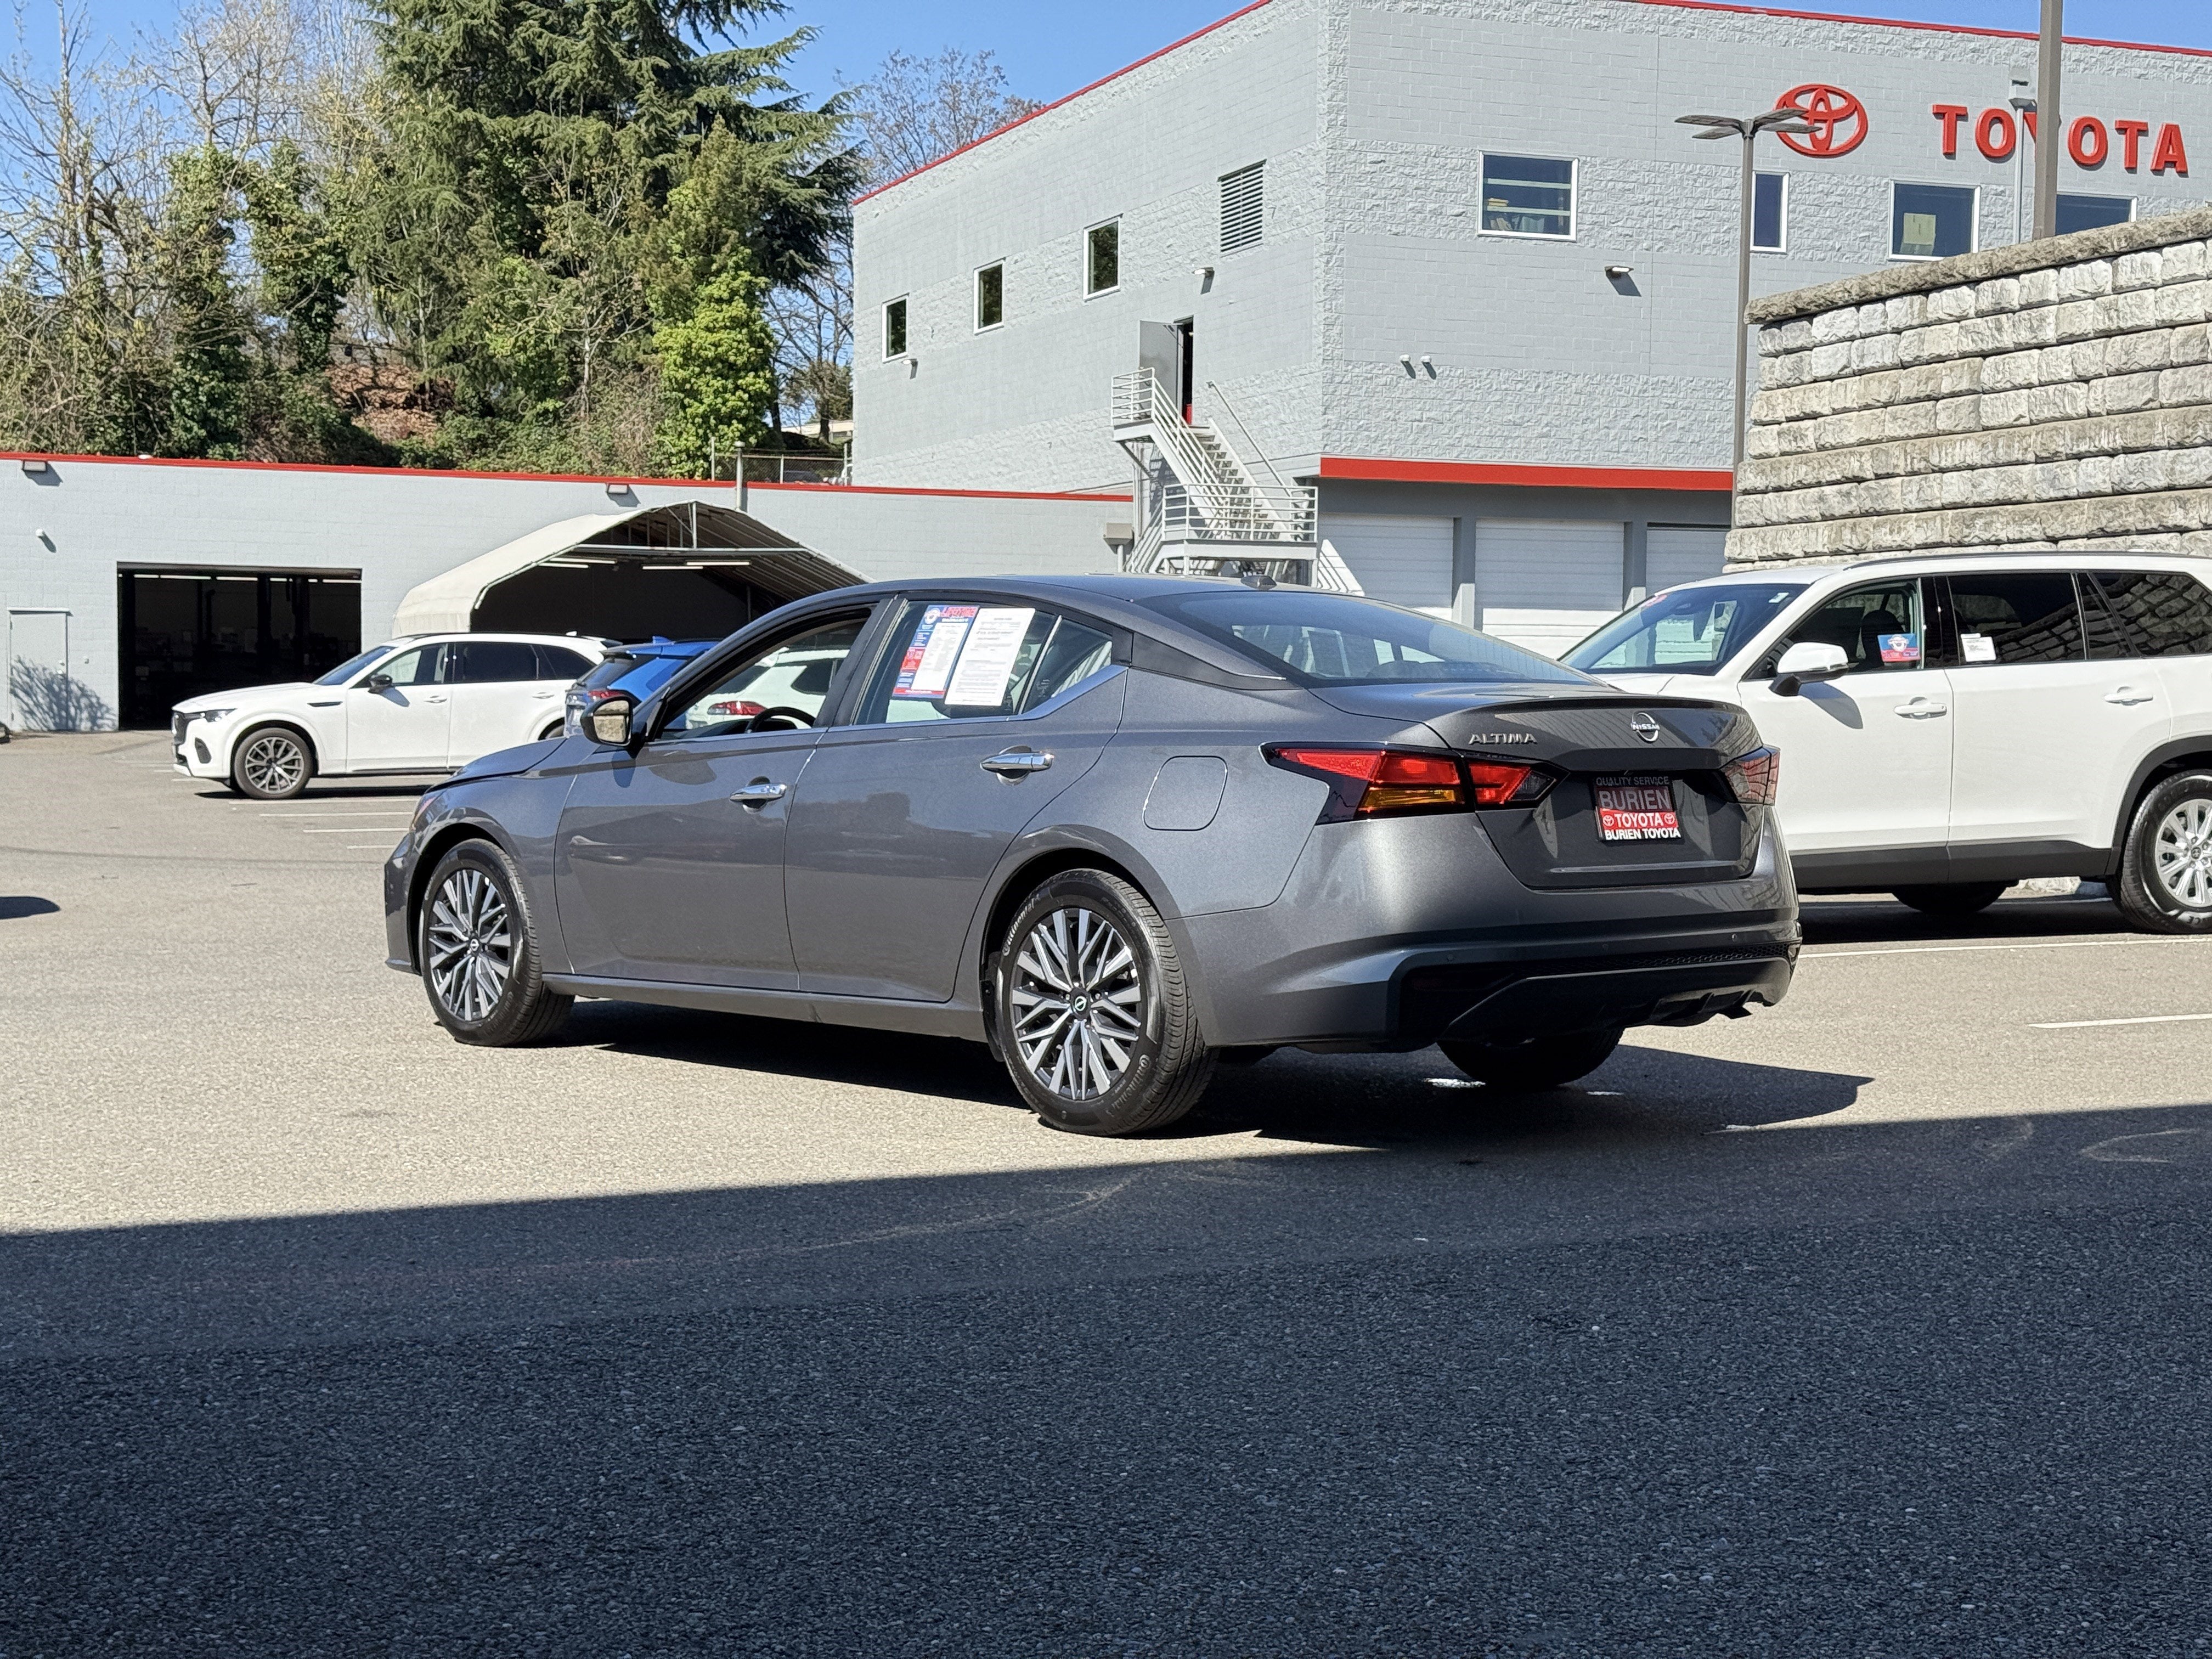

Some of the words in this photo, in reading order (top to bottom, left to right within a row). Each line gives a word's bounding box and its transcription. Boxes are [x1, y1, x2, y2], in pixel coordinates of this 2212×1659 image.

[1468, 733, 1537, 744] ALTIMA
[1596, 777, 1632, 786] QUALITY
[1633, 776, 1669, 785] SERVICE
[1599, 789, 1671, 810] BURIEN
[1613, 812, 1664, 828] TOYOTA
[1604, 828, 1642, 840] BURIEN
[1642, 827, 1681, 839] TOYOTA
